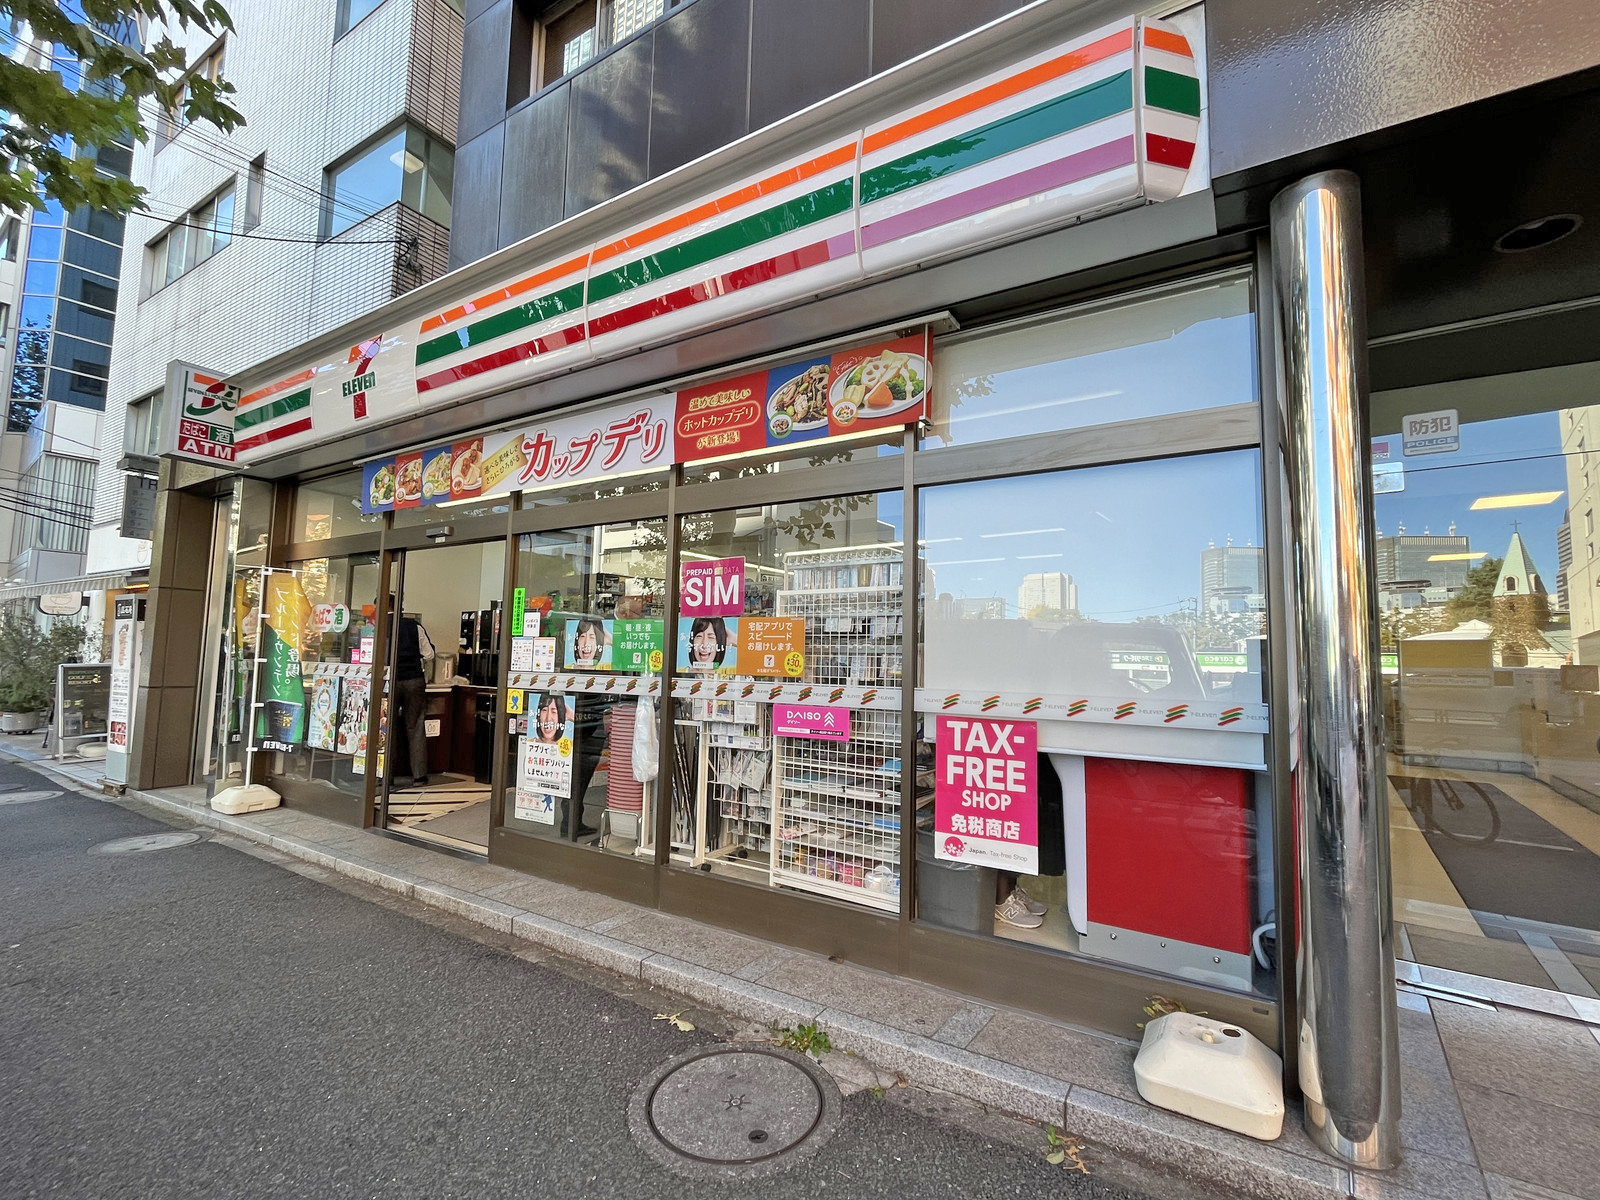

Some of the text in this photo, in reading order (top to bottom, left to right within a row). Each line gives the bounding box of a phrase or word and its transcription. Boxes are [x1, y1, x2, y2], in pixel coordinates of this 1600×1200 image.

[689, 389, 751, 411] 温めて美味しい
[683, 407, 754, 432] ホットカップデリ
[1409, 416, 1452, 436] 防犯
[182, 421, 231, 443] たばこ 酒
[183, 439, 232, 459] ATM
[519, 410, 665, 483] カップデリ
[1407, 437, 1455, 448] POLICE
[686, 568, 713, 576] PREPAID
[685, 575, 740, 607] SIM
[748, 622, 793, 631] 宅配アプリで
[626, 633, 650, 641] いつでも
[747, 642, 795, 652] お届けします。
[787, 710, 821, 721] DAISO
[947, 721, 1025, 756] TAX-
[528, 744, 549, 755] アプリで
[528, 756, 570, 768] お気軽デリバリー
[947, 754, 1027, 793] FREE
[961, 790, 1012, 811] SHOP
[951, 813, 1021, 841] 免税商店
[990, 851, 1012, 859] Tax-free
[1013, 853, 1028, 862] Shop
